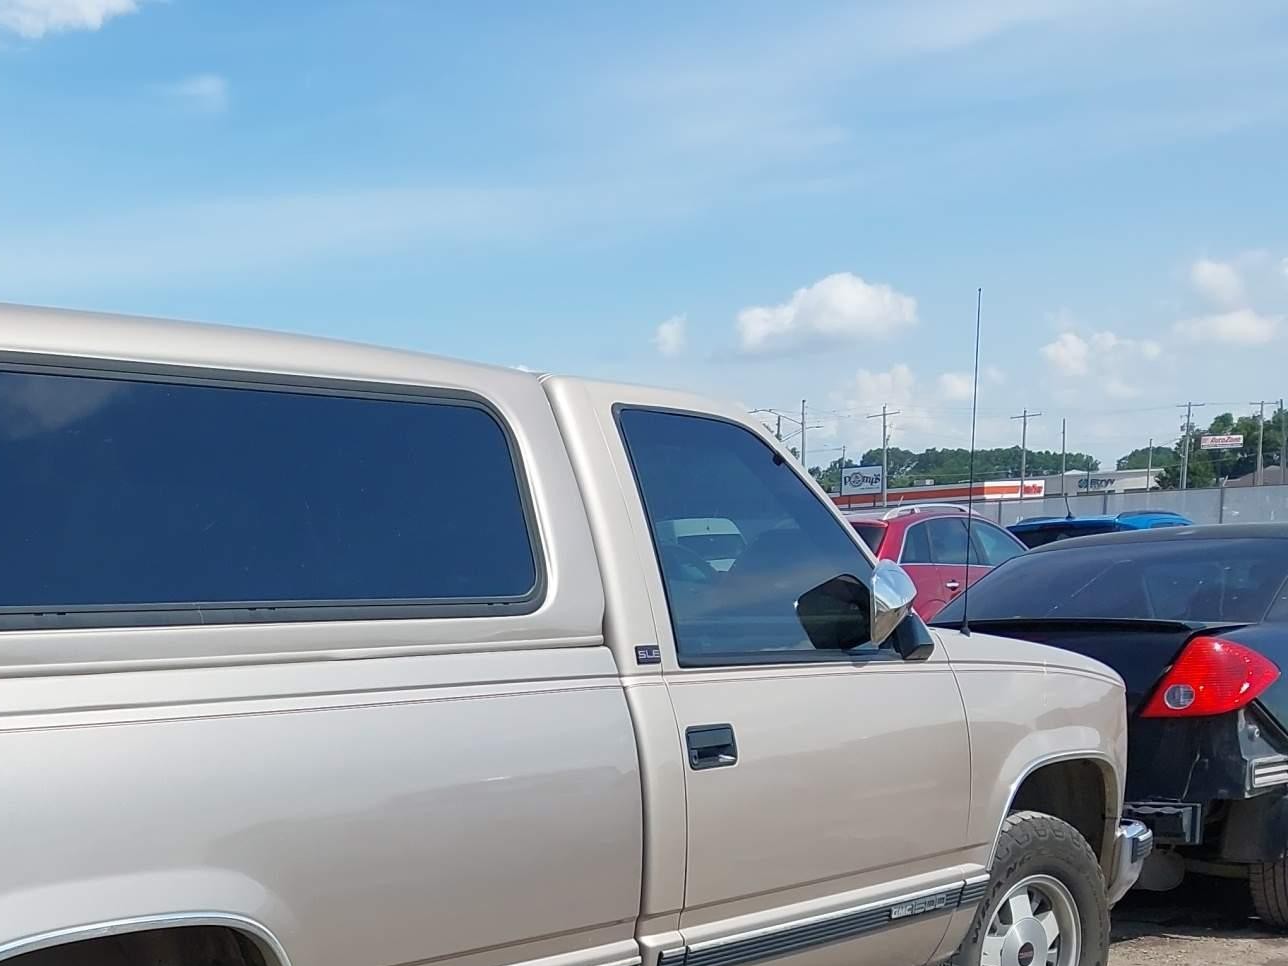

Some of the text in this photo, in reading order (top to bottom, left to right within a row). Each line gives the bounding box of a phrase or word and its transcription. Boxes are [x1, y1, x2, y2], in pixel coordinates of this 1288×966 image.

[638, 650, 661, 659] SLE
[891, 893, 947, 919] GMC 1500
